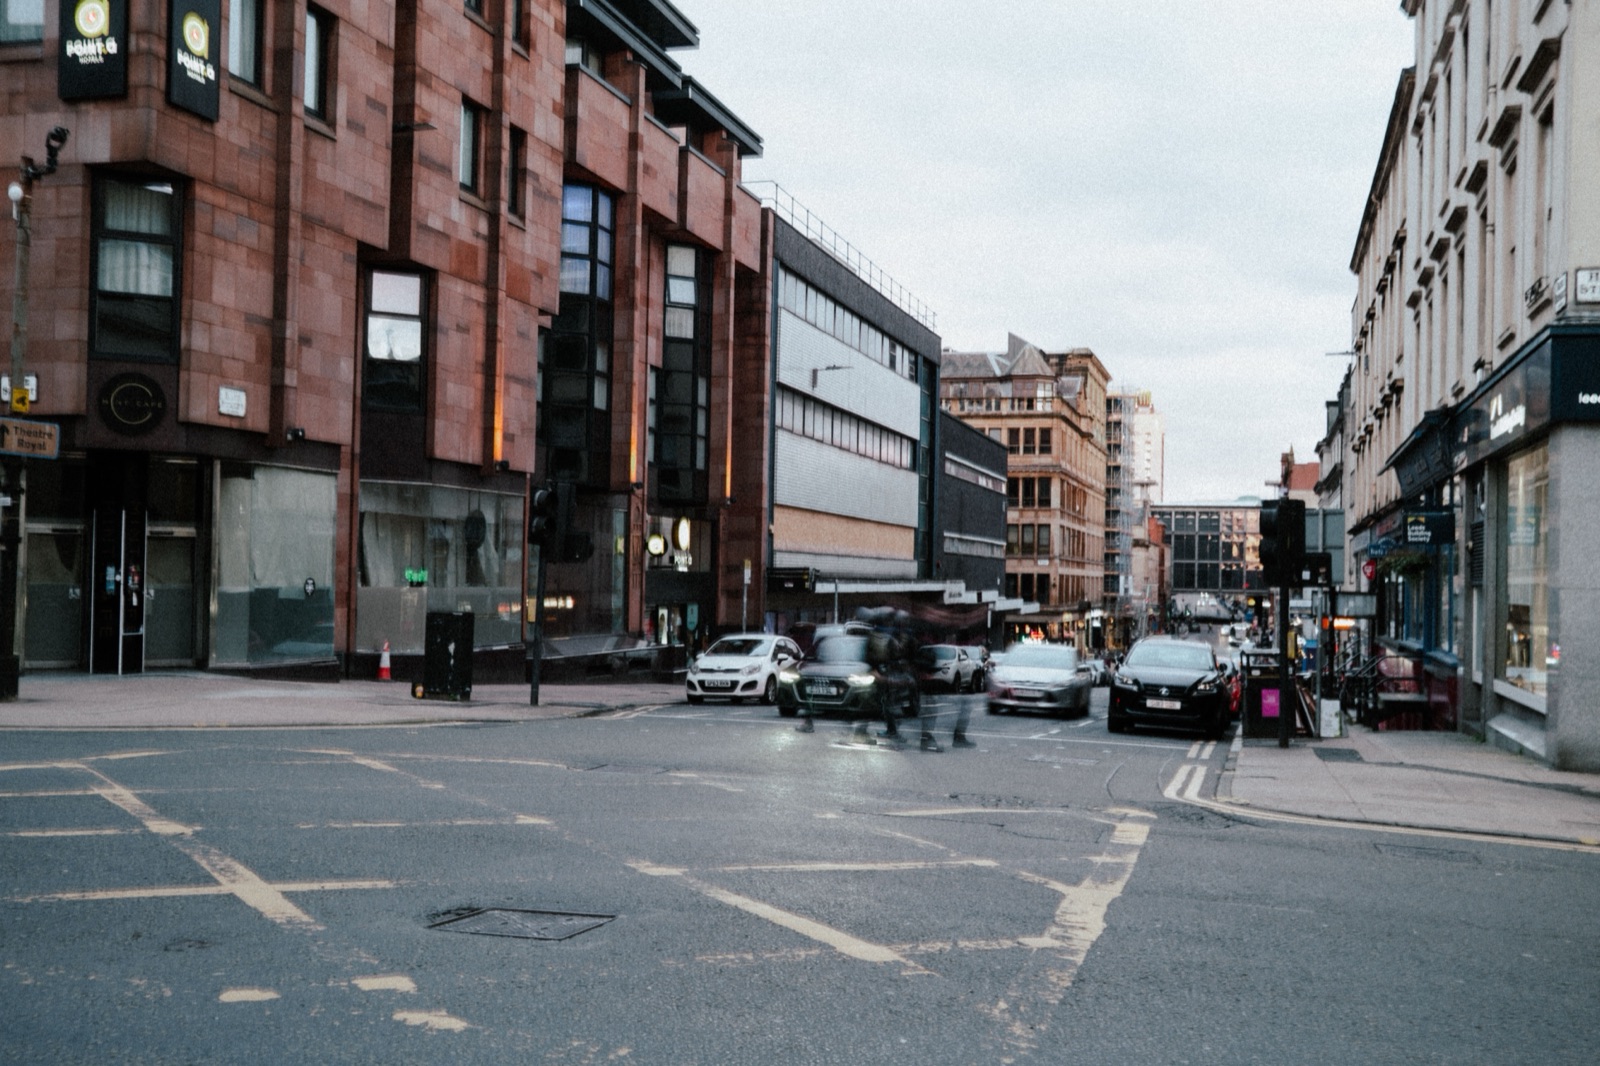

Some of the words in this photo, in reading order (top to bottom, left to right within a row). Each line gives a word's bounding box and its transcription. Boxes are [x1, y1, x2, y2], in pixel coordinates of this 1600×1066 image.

[66, 38, 103, 58] POINT
[13, 425, 53, 440] Theatre
[17, 438, 47, 452] Royal
